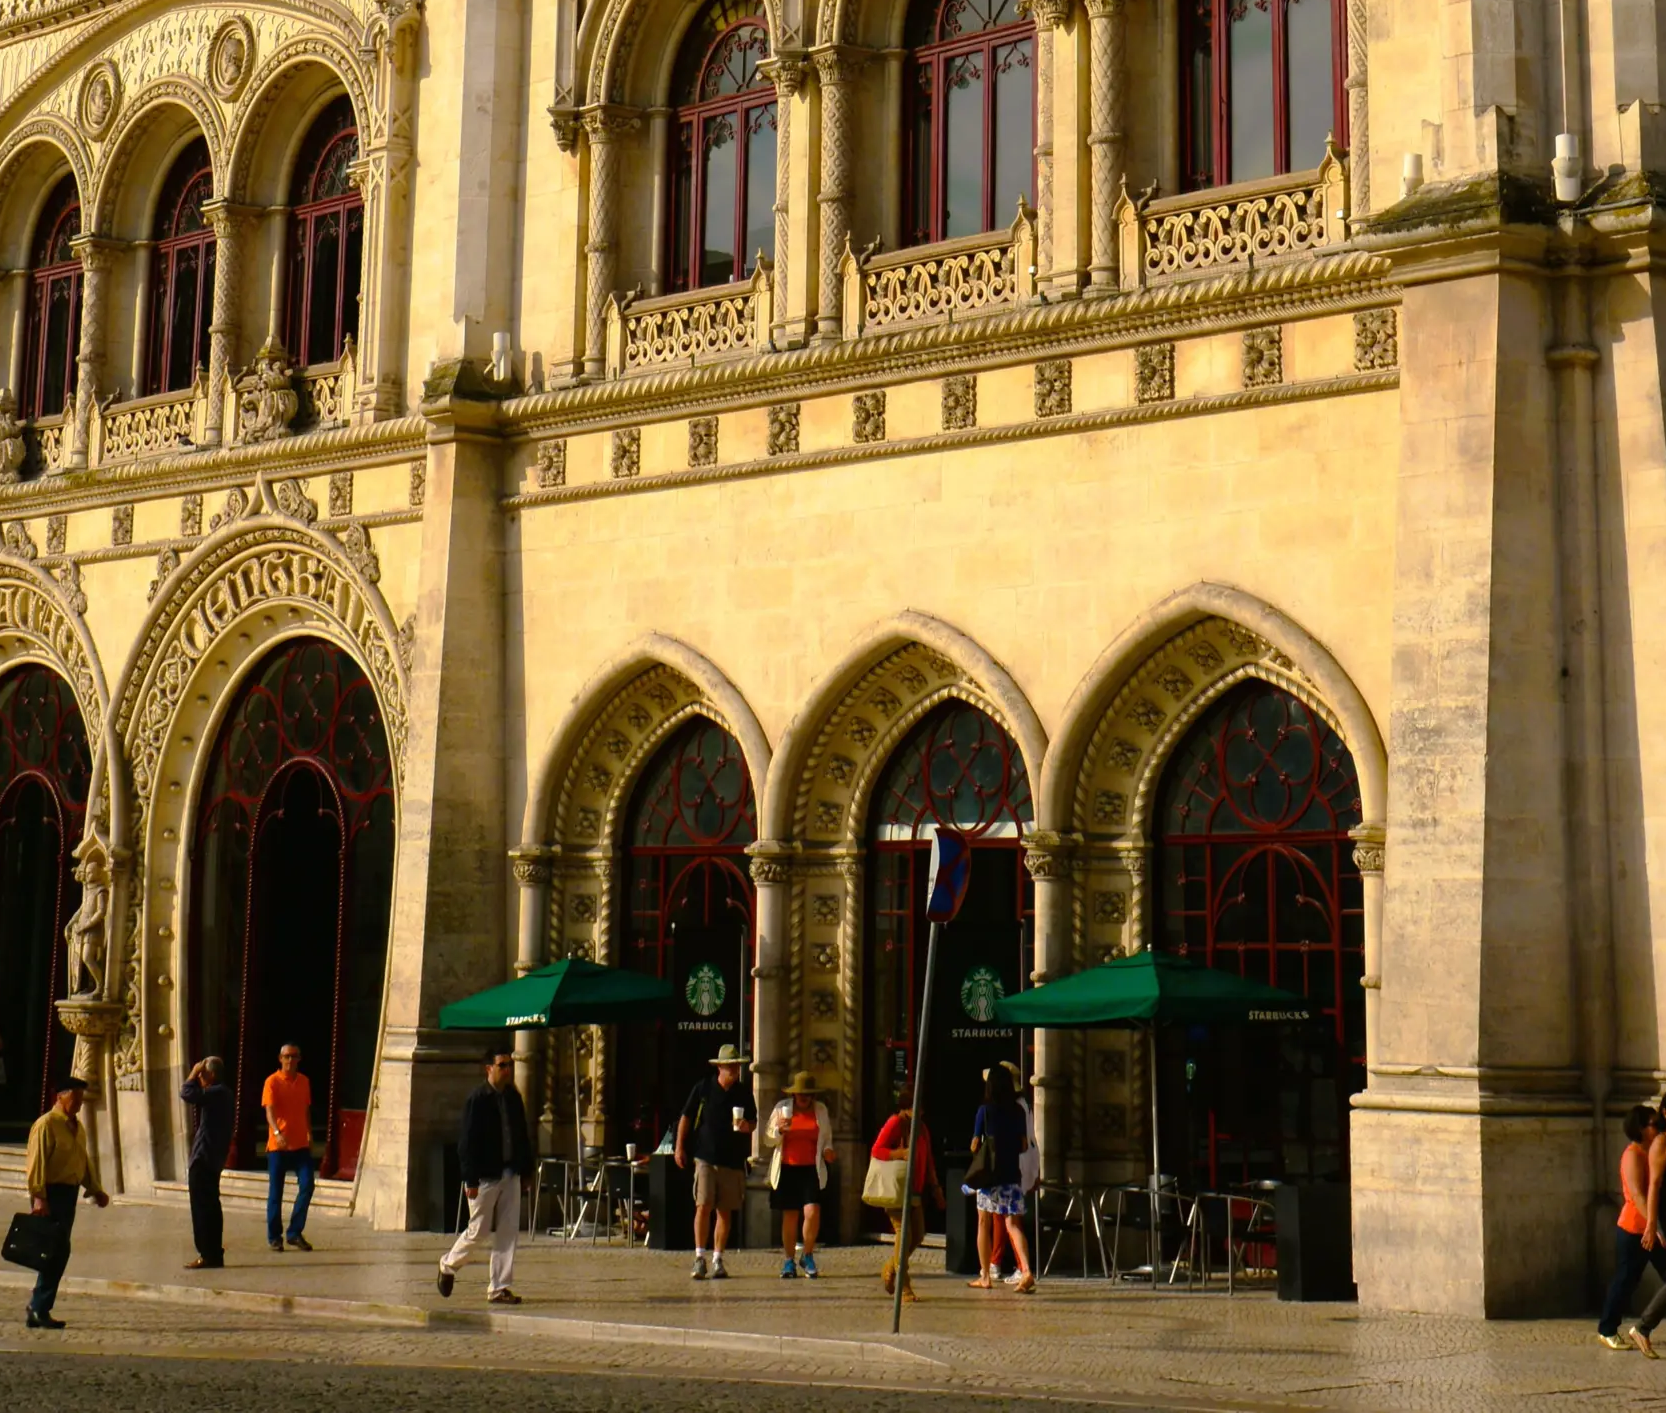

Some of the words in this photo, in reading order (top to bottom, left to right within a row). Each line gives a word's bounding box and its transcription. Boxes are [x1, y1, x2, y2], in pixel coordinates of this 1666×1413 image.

[1248, 1009, 1310, 1020] STARBUCKS
[678, 1021, 734, 1030] STARBUCKS
[951, 1028, 1013, 1038] STARBUCKS
